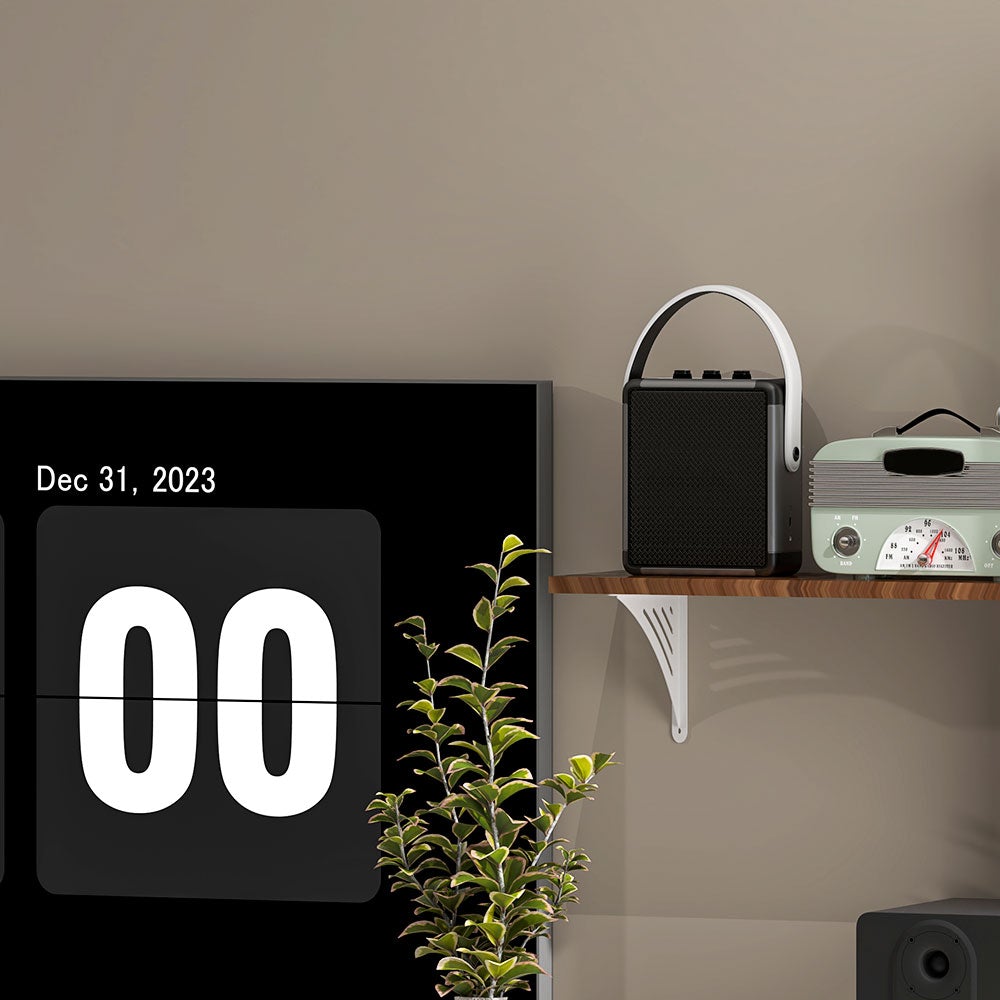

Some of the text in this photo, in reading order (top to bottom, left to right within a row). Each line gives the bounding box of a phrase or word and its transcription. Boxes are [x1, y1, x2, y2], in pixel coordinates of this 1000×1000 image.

[37, 464, 216, 496] Dec 31, 2023
[905, 525, 912, 533] 92
[924, 519, 932, 527] 96
[79, 585, 337, 818] 00
